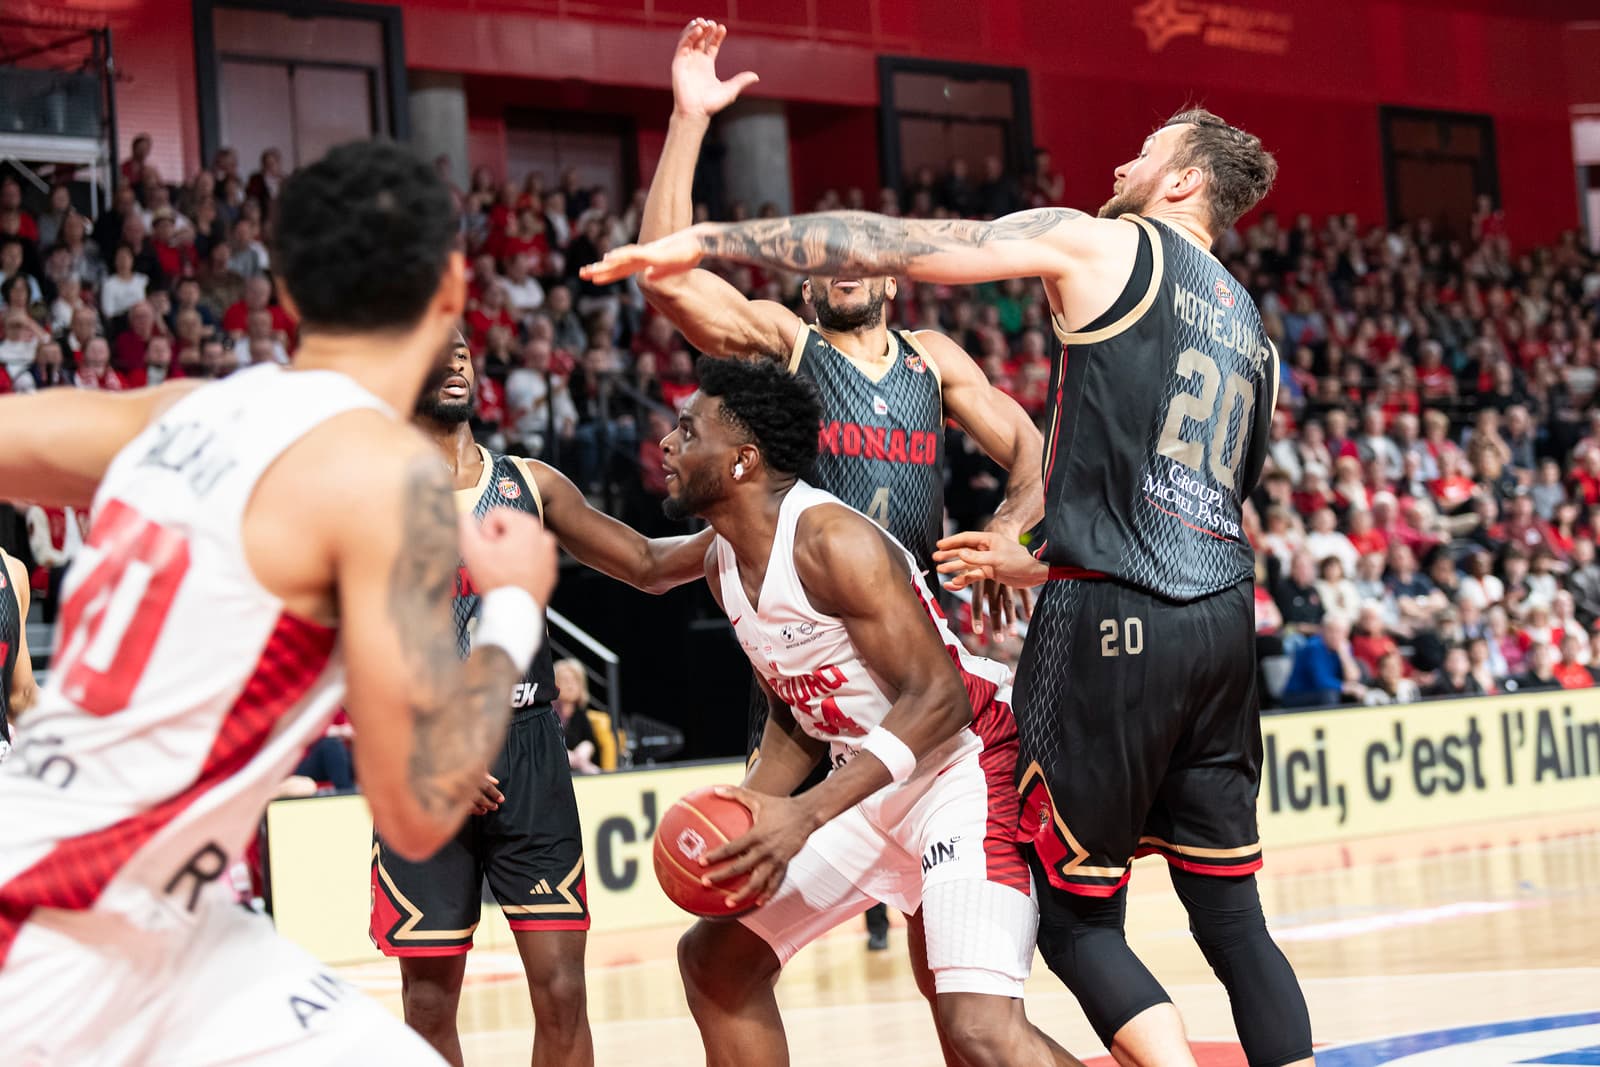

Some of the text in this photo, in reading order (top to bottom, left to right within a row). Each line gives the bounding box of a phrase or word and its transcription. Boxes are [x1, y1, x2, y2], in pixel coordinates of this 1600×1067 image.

[818, 419, 936, 466] MONACO
[1156, 347, 1255, 491] 20
[865, 487, 890, 531] 4
[1099, 616, 1144, 657] 20
[1265, 727, 1348, 825] Ici,
[1365, 714, 1486, 803] c'est
[164, 838, 230, 913] R
[921, 841, 954, 875] AIN
